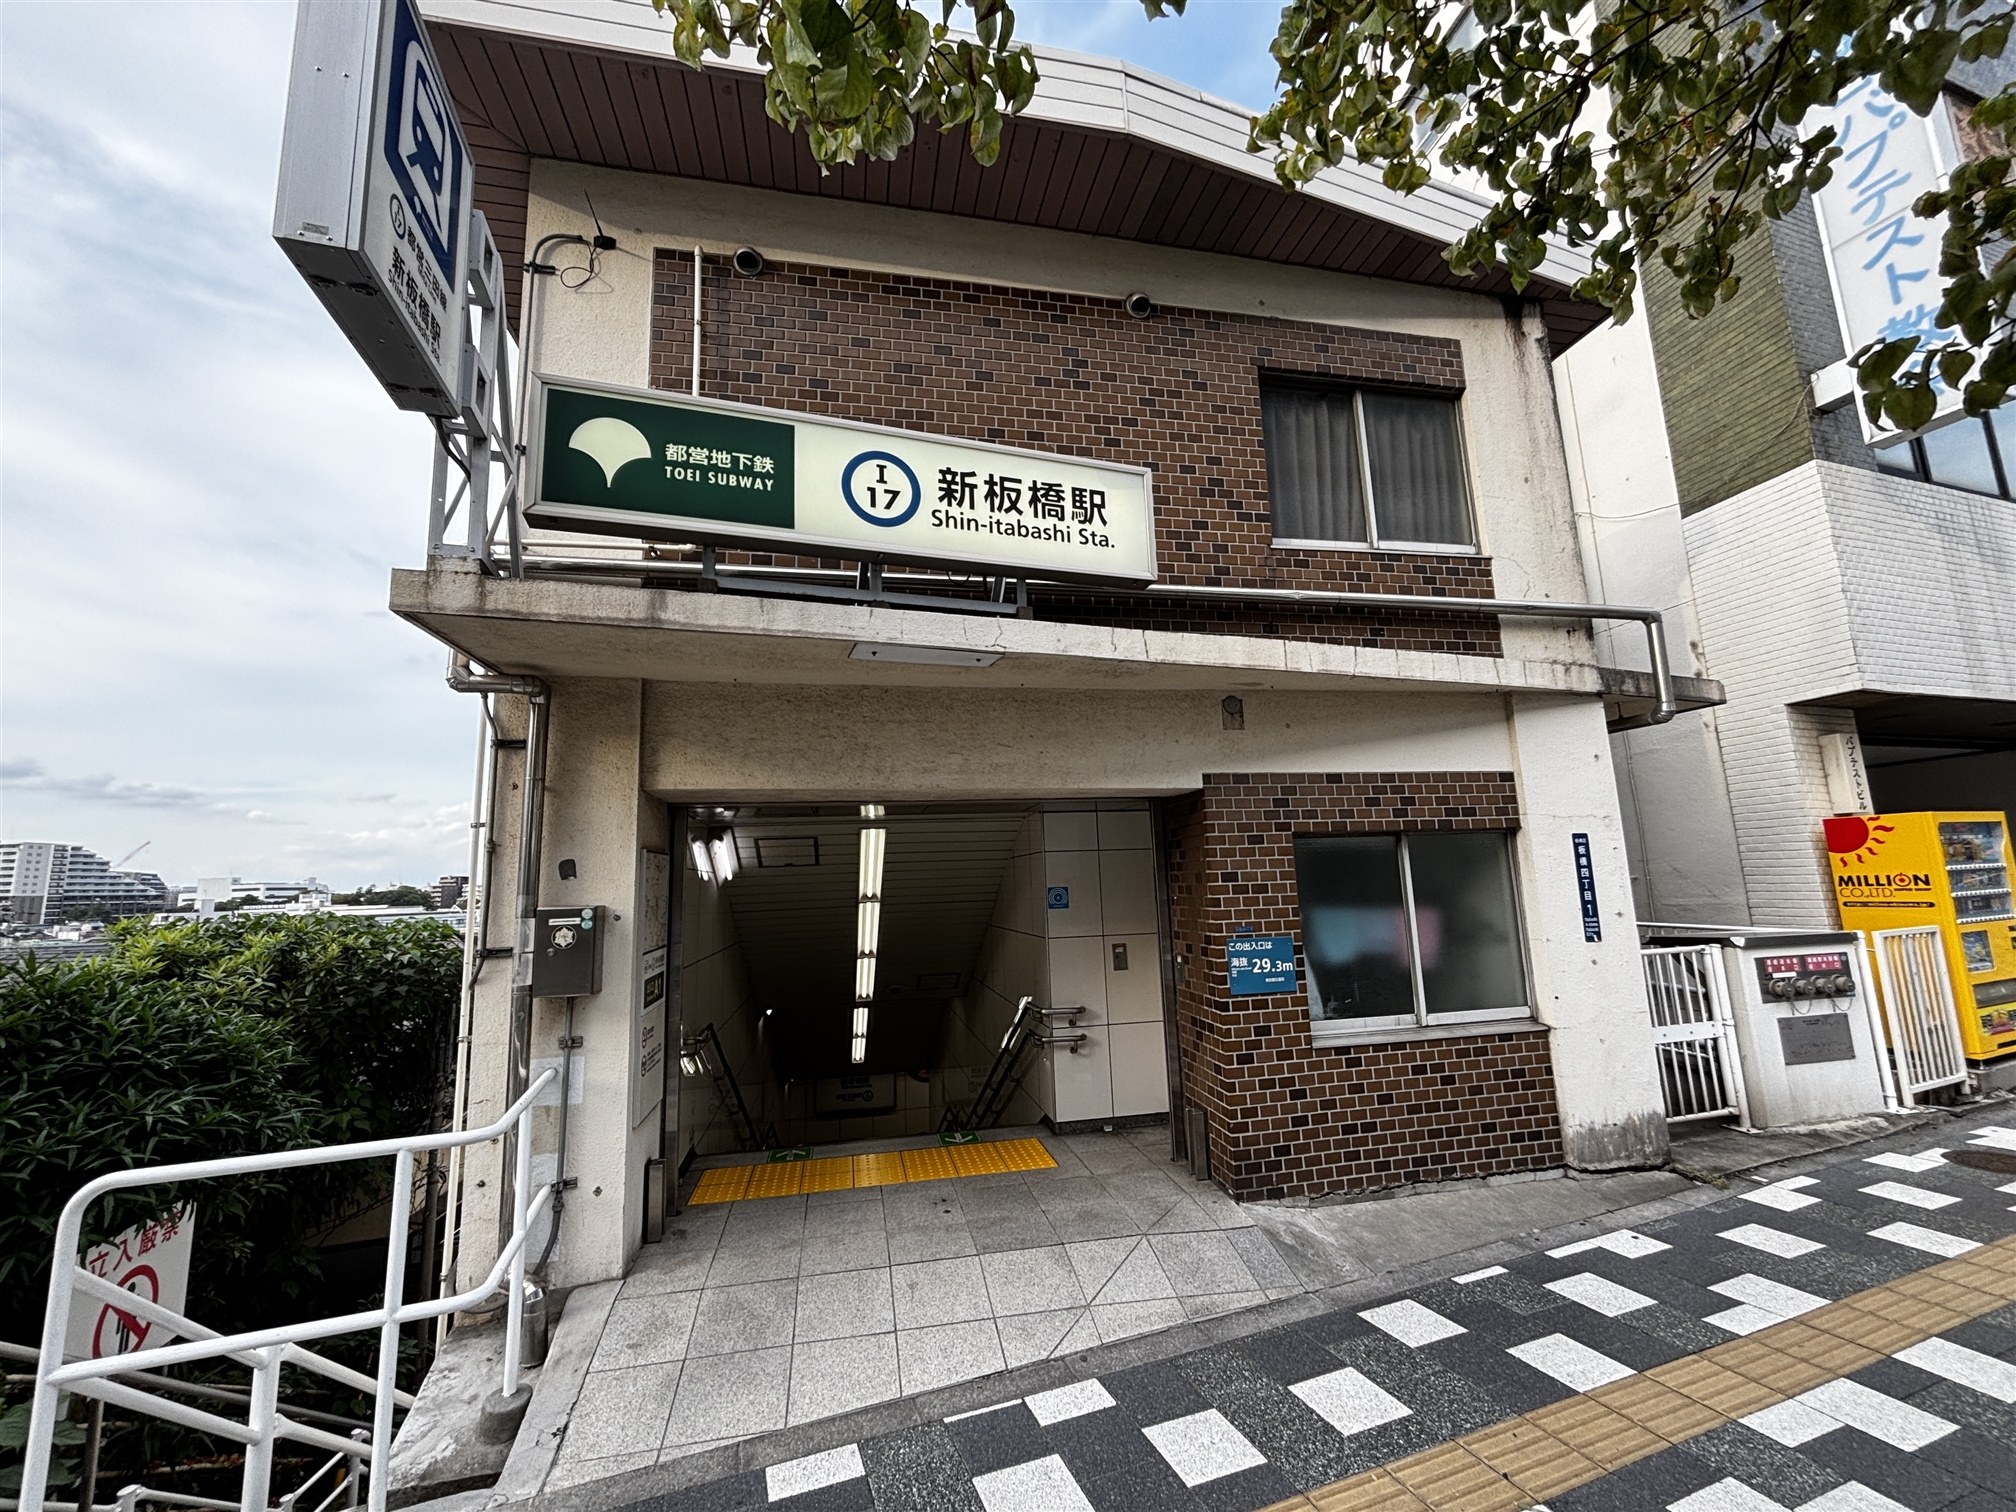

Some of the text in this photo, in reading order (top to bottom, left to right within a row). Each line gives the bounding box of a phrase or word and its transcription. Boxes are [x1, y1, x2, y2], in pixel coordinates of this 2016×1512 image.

[391, 244, 442, 350] 新板橋駅
[664, 443, 775, 475] 都営地下鉄
[664, 465, 774, 492] TOEI SUBWAY
[875, 463, 888, 485] I
[866, 486, 902, 511] 17
[937, 466, 1108, 527] 新板橋駅
[931, 509, 1116, 549] Shin-itabashi Sta.
[1838, 872, 1931, 888] MILLION
[1228, 941, 1273, 951] この出入口は
[1230, 957, 1249, 967] 海抜
[1252, 958, 1294, 974] 29.3m
